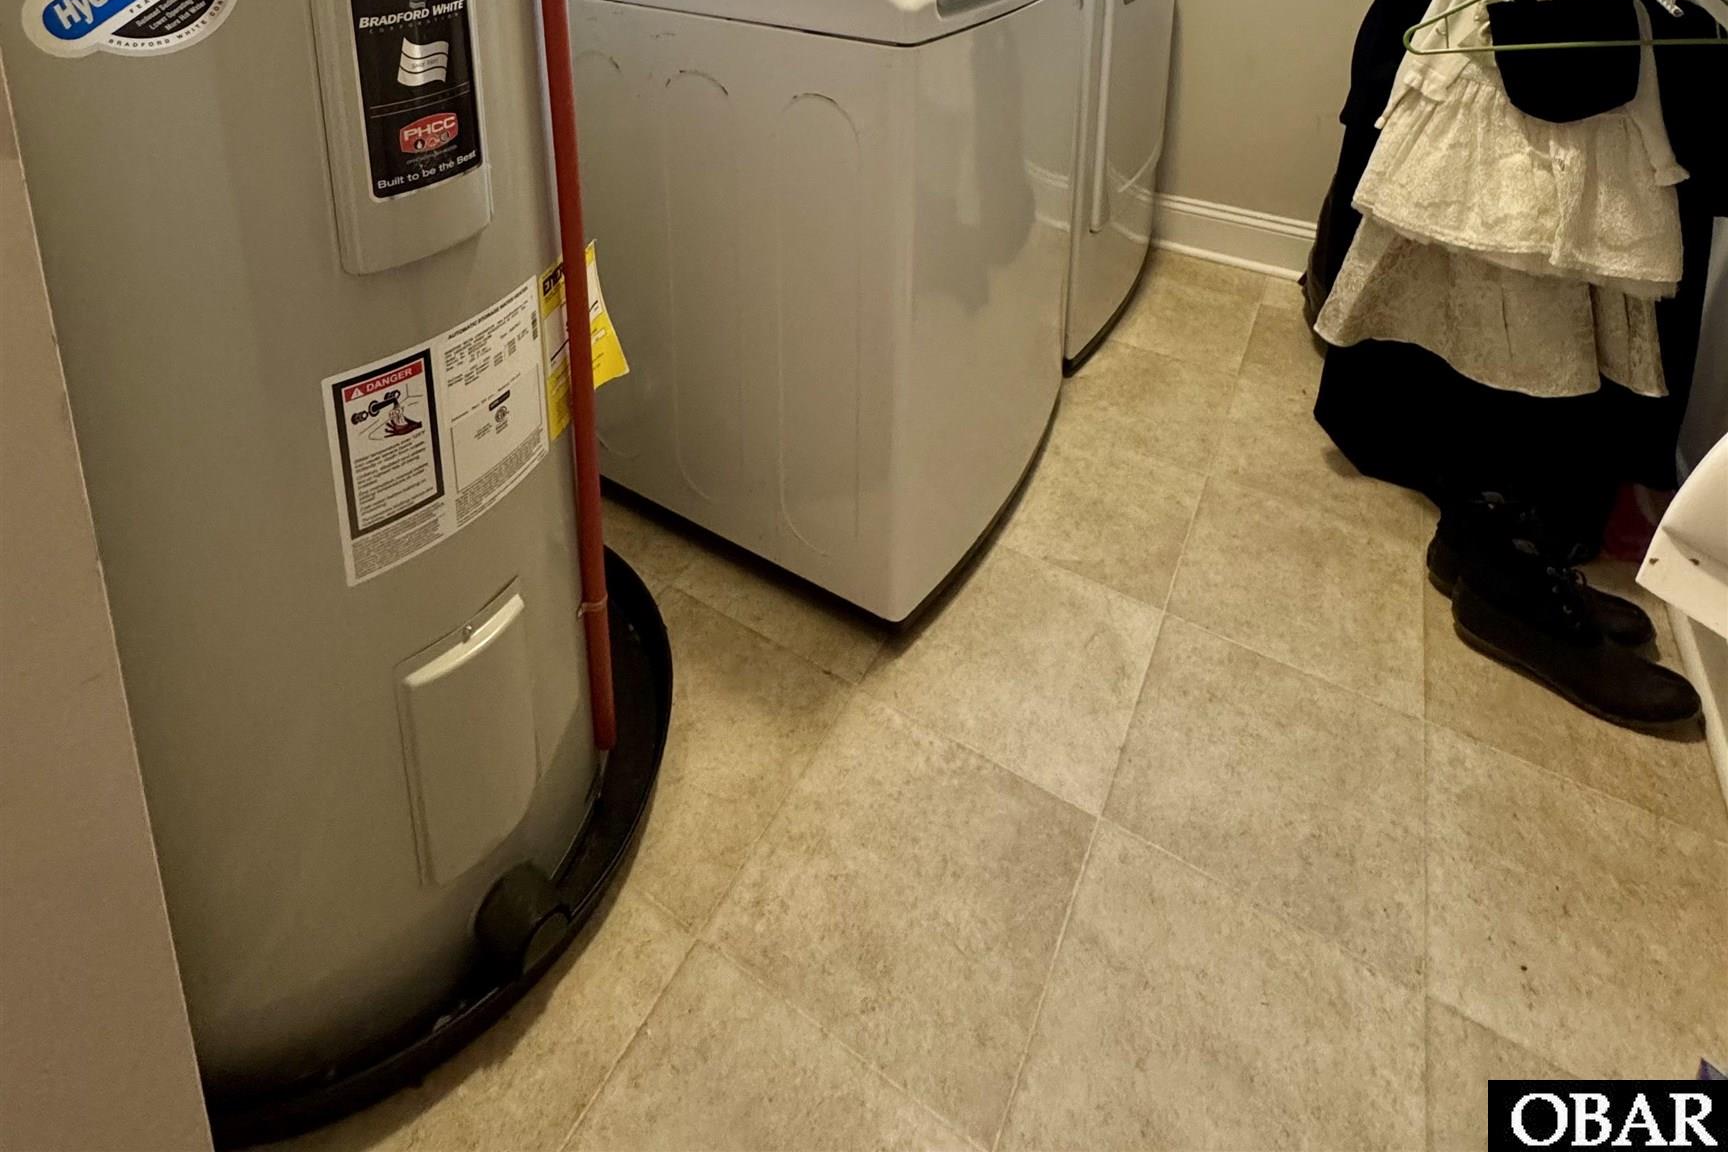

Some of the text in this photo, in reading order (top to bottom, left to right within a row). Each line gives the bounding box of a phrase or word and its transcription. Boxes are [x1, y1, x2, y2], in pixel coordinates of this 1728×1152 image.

[359, 0, 465, 29] BRADFORD WHITE
[108, 37, 171, 48] BRADFORD
[176, 19, 207, 40] WHITE
[403, 116, 456, 141] PHCC
[377, 176, 405, 189] Built
[407, 171, 420, 182] to
[422, 165, 437, 177] be
[439, 158, 455, 172] the
[456, 150, 477, 165] Best
[366, 368, 413, 392] DANGER
